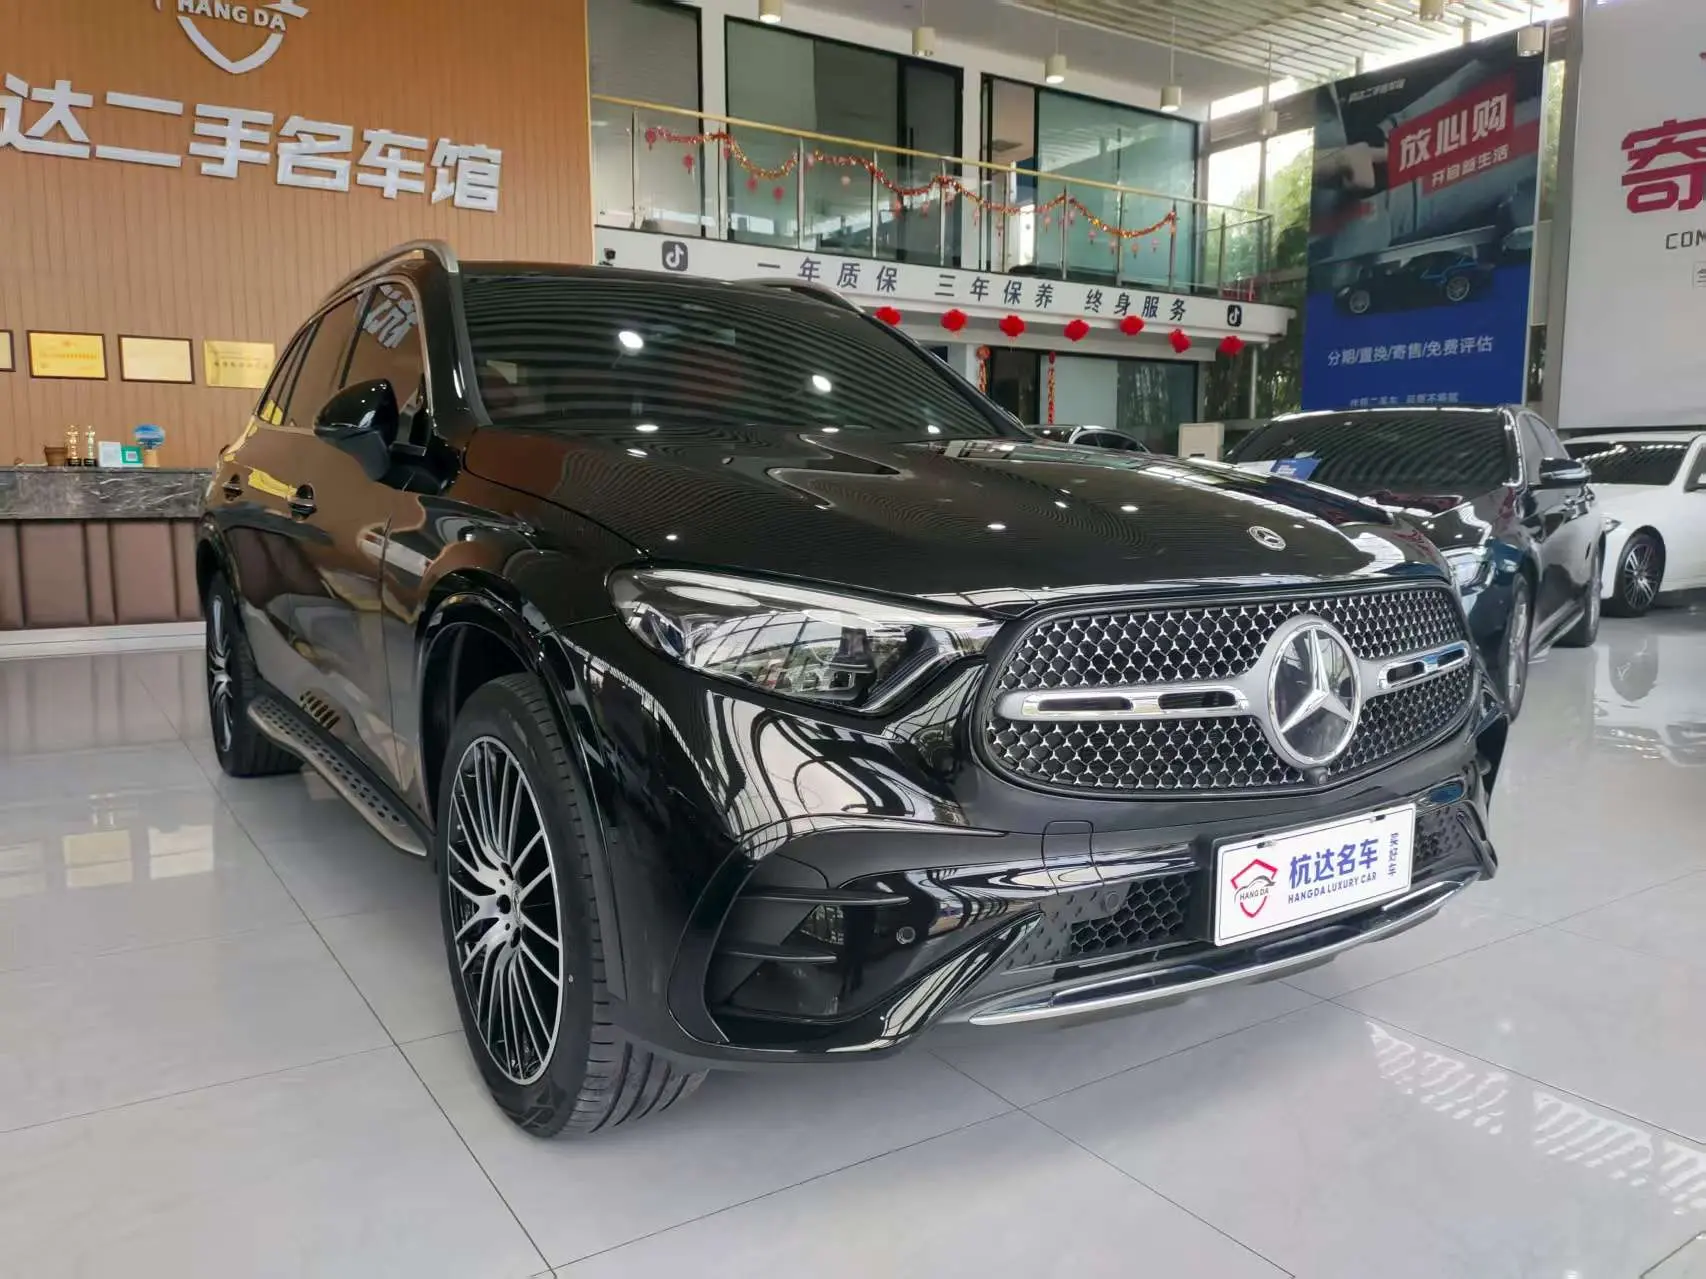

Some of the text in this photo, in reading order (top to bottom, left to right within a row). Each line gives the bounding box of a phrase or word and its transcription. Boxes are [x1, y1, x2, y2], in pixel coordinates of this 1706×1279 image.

[178, 0, 287, 31] HANG DA
[0, 73, 502, 212] 达二手名车馆
[1399, 93, 1507, 172] 放心购
[757, 257, 1187, 321] 一年质保 三年保养 终身服务
[1288, 872, 1377, 904] HANGDA LUXURY CAR
[1289, 838, 1379, 889] 杭达名车
[1239, 887, 1269, 900] HANG DA
